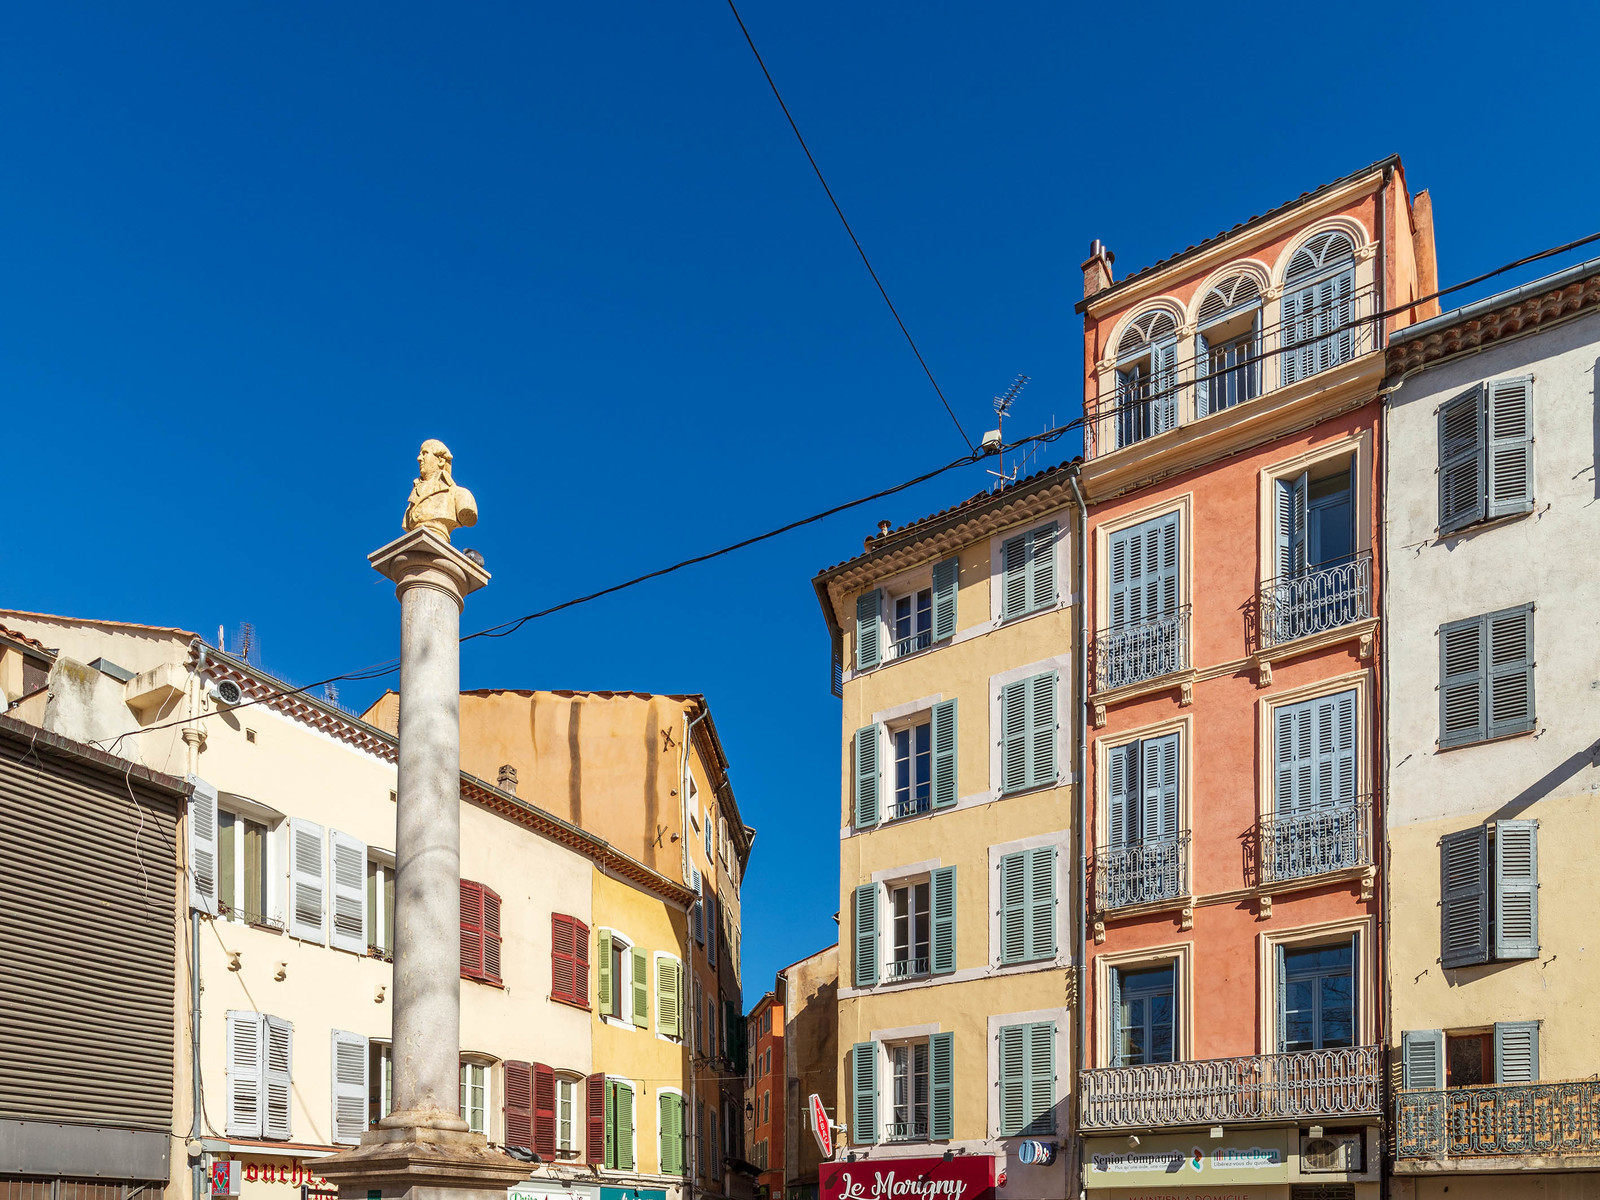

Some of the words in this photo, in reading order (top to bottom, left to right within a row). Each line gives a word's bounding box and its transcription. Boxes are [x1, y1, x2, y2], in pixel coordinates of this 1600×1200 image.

[816, 1108, 830, 1145] TABAC
[1093, 1154, 1124, 1165] Senior
[1126, 1152, 1184, 1165] Compagnie
[1228, 1149, 1278, 1161] FreeDom
